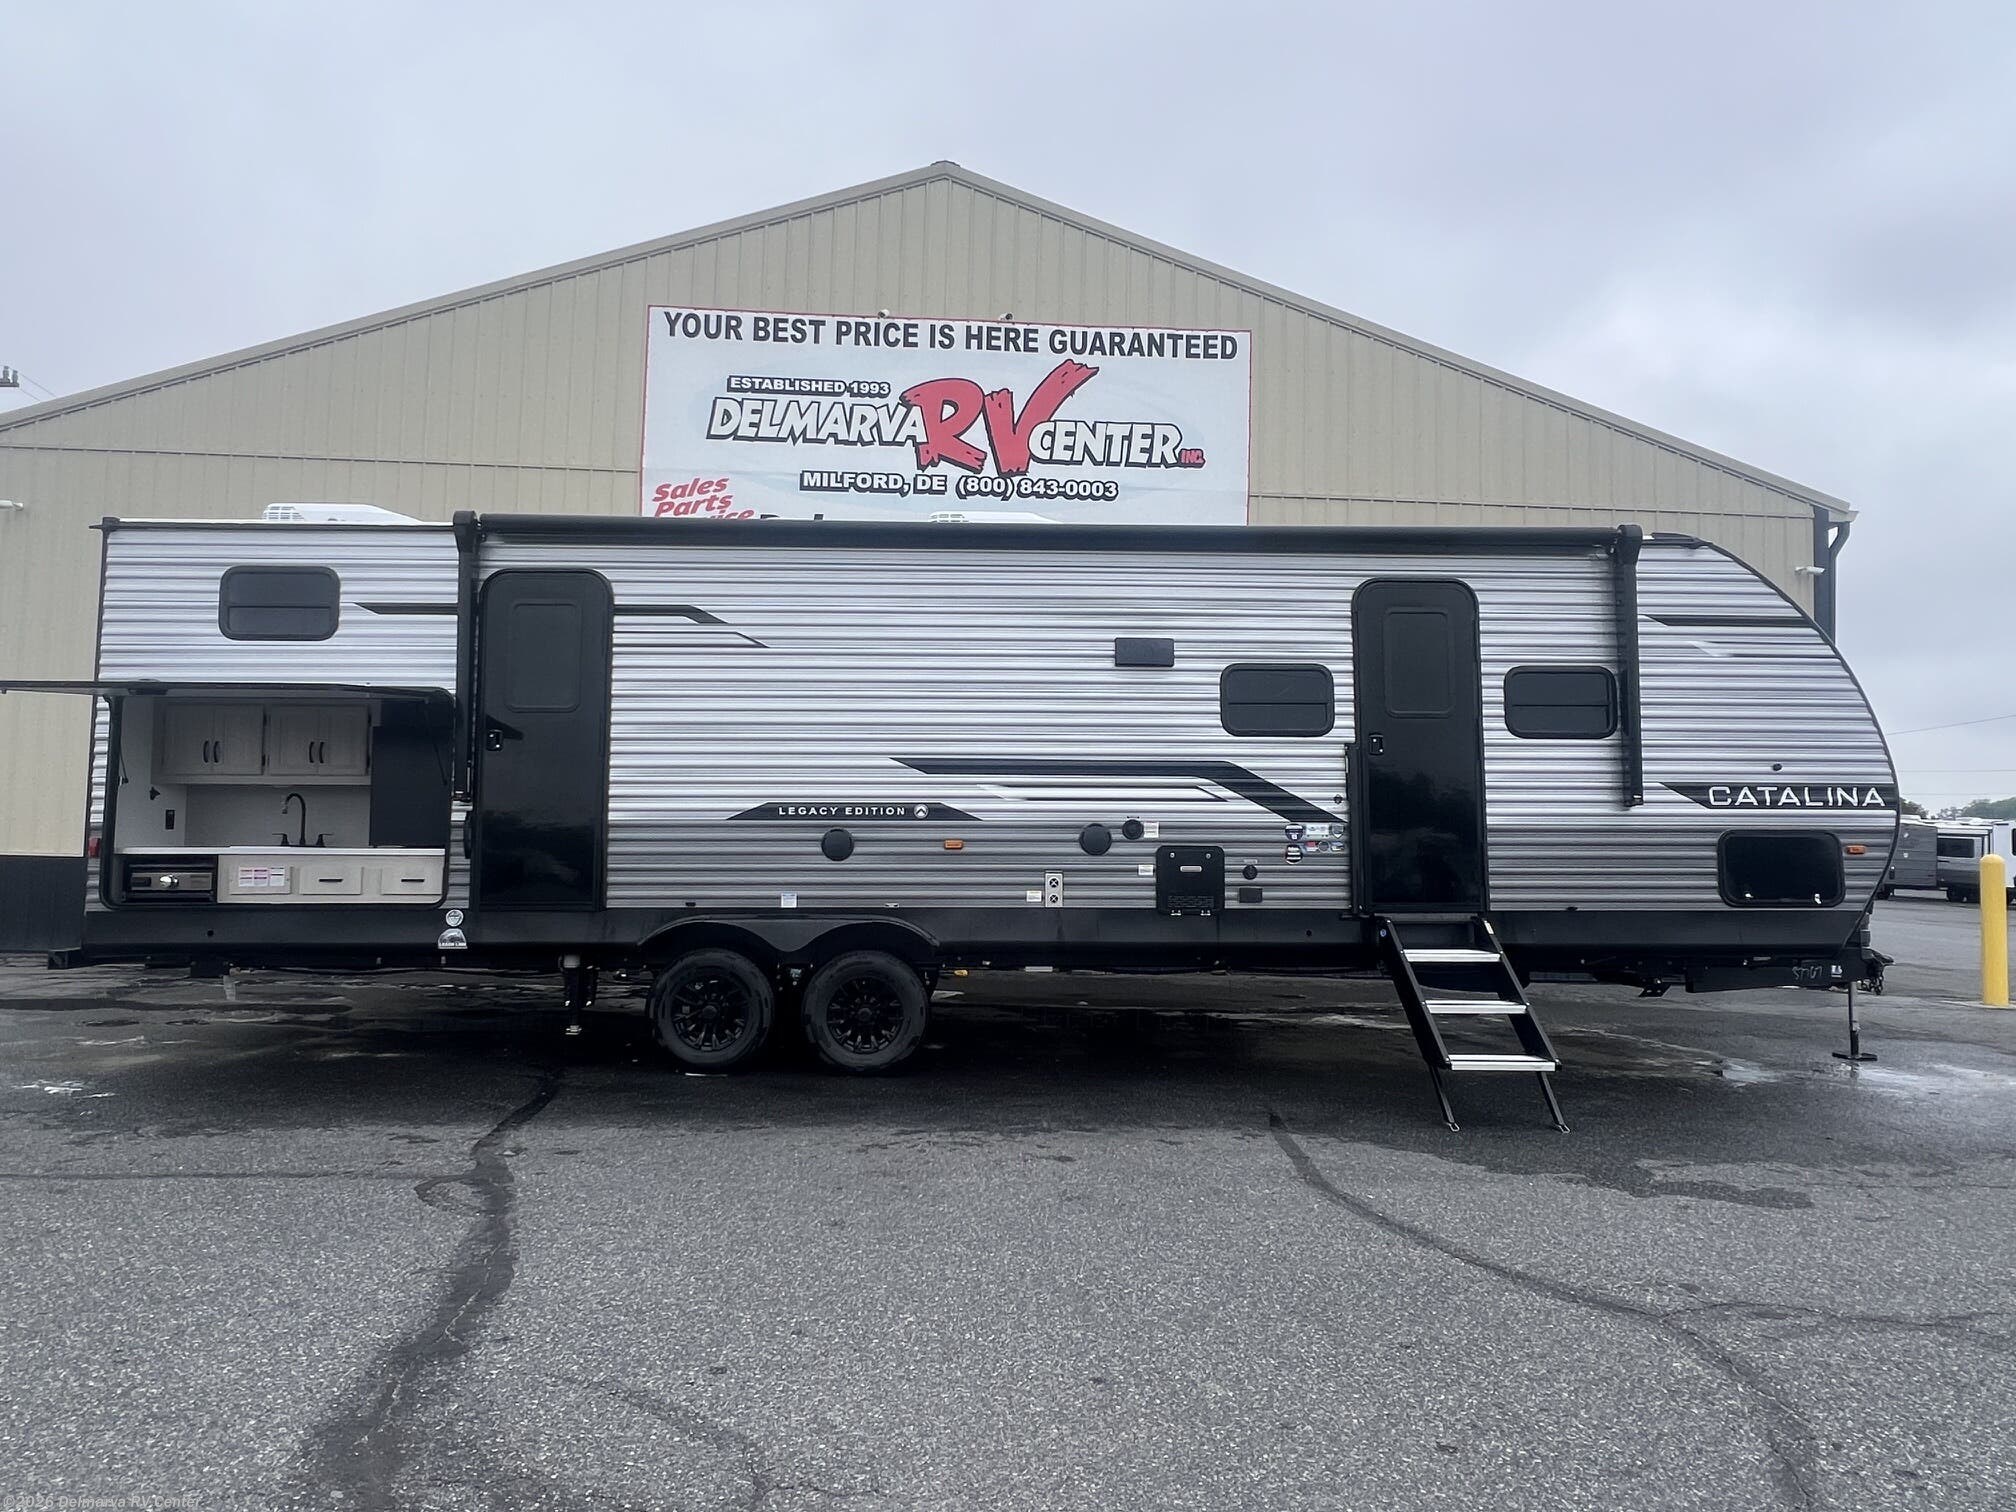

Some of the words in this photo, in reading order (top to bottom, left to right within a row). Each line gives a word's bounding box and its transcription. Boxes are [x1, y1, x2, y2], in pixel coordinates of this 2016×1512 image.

[664, 311, 743, 341] YOUR
[753, 316, 826, 345] BEST
[836, 320, 919, 348] PRICE
[929, 323, 955, 350] IS
[965, 325, 1039, 353] HERE
[1049, 329, 1238, 360] GUARANTEED
[728, 376, 846, 395] ESTABLISHED
[847, 381, 891, 397] 1993
[707, 397, 928, 445] DELMARVA
[900, 359, 1100, 475] RV
[1028, 420, 1182, 467] CENTER
[652, 477, 730, 502] Sales
[800, 471, 910, 496] MILFORD,
[914, 474, 947, 495] DE
[956, 474, 1012, 500] (800)
[1018, 478, 1119, 500] 843-0003
[655, 494, 733, 517] Parts
[1708, 786, 1886, 807] CATALINA
[778, 806, 838, 816] LEGACY
[845, 806, 905, 816] EDITION
